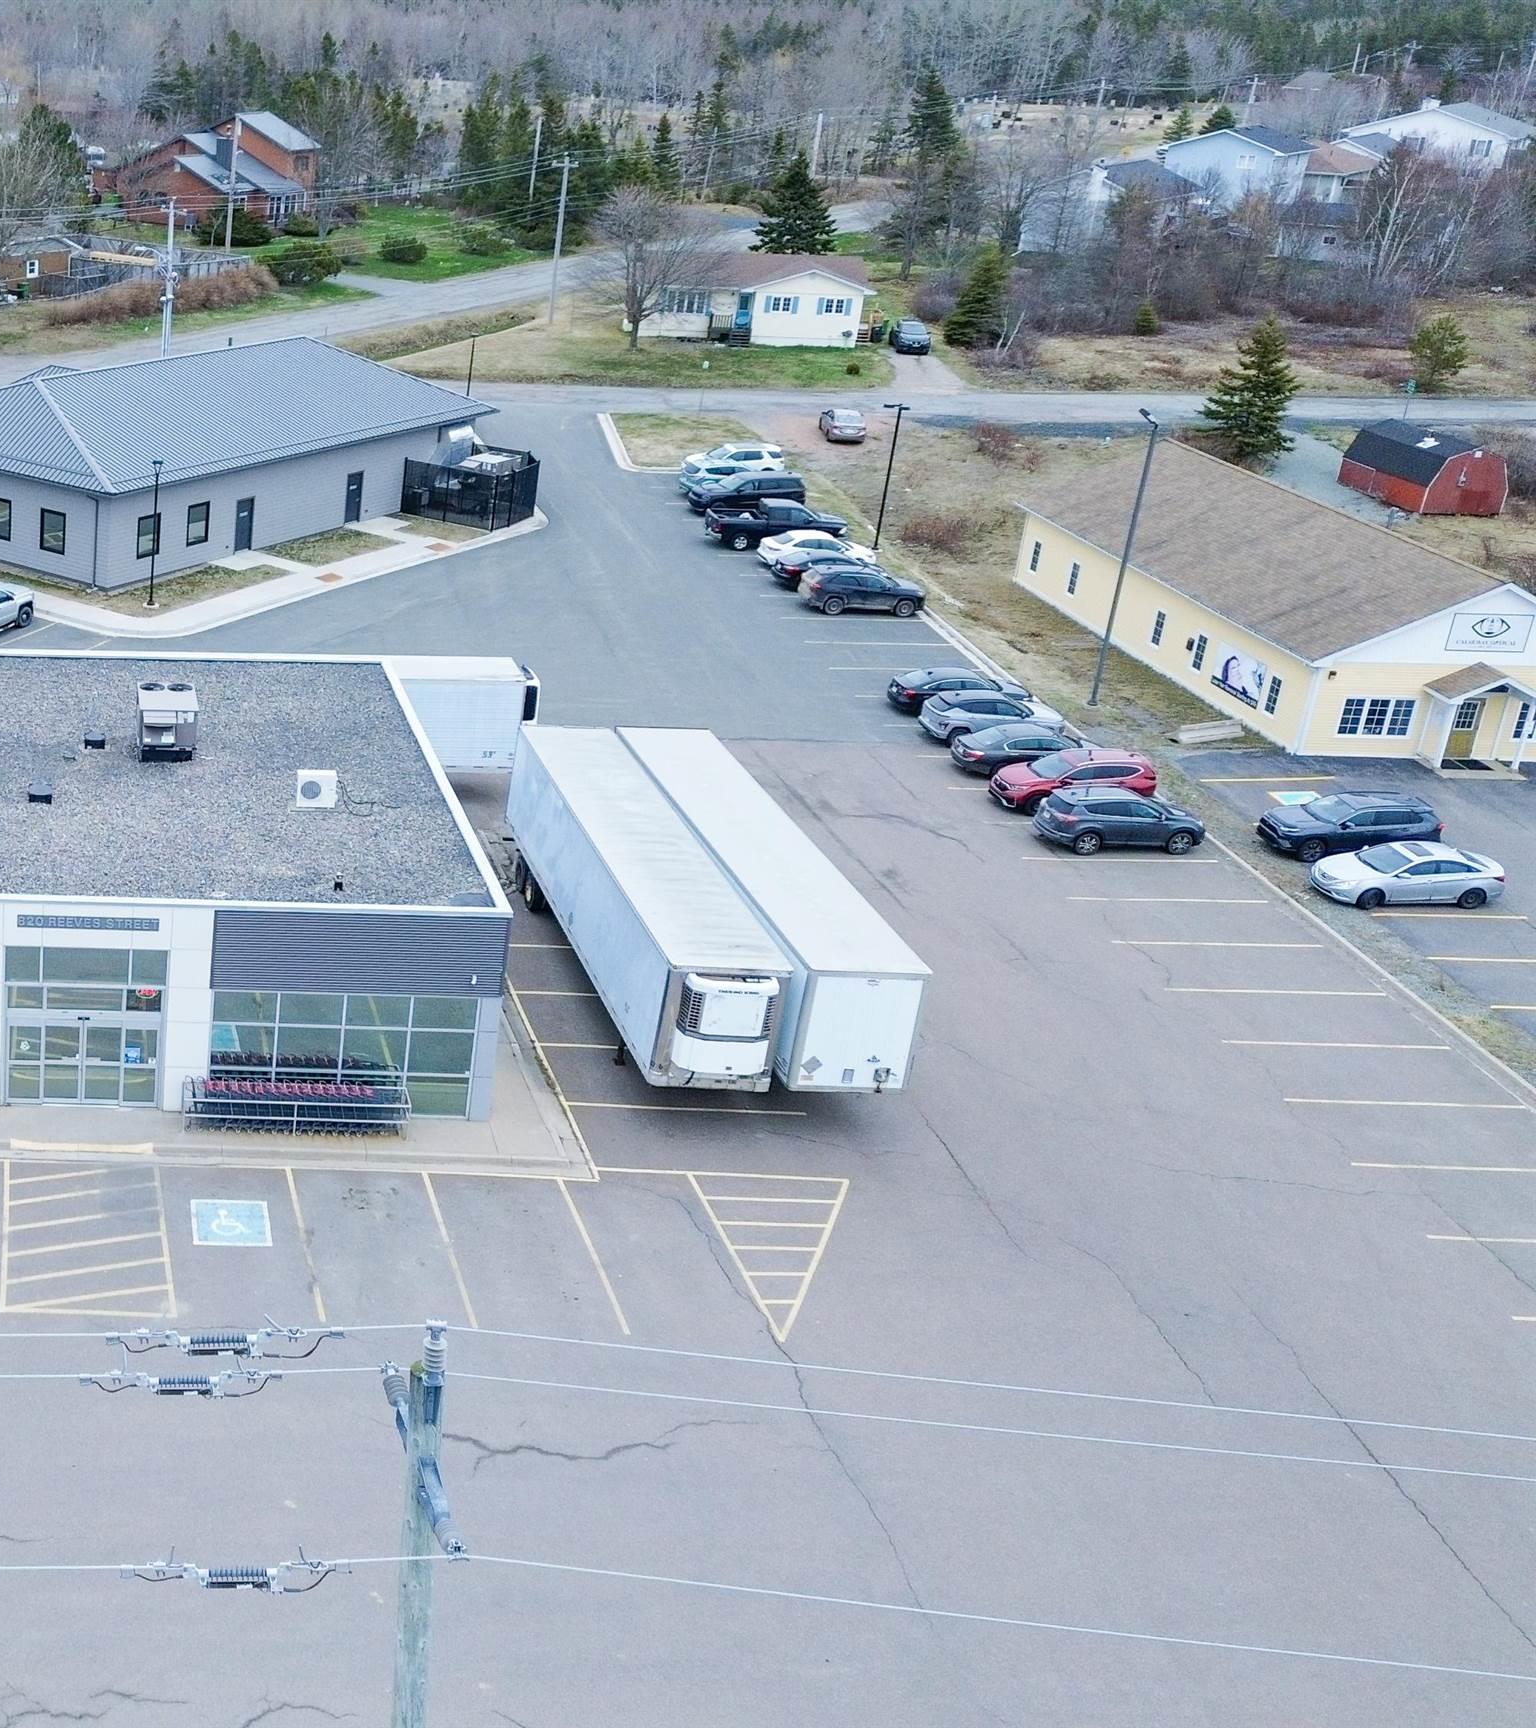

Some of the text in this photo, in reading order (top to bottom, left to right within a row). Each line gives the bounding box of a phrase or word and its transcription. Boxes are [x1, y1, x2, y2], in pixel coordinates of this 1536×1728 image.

[18, 916, 160, 930] 820 REEVES STREET
